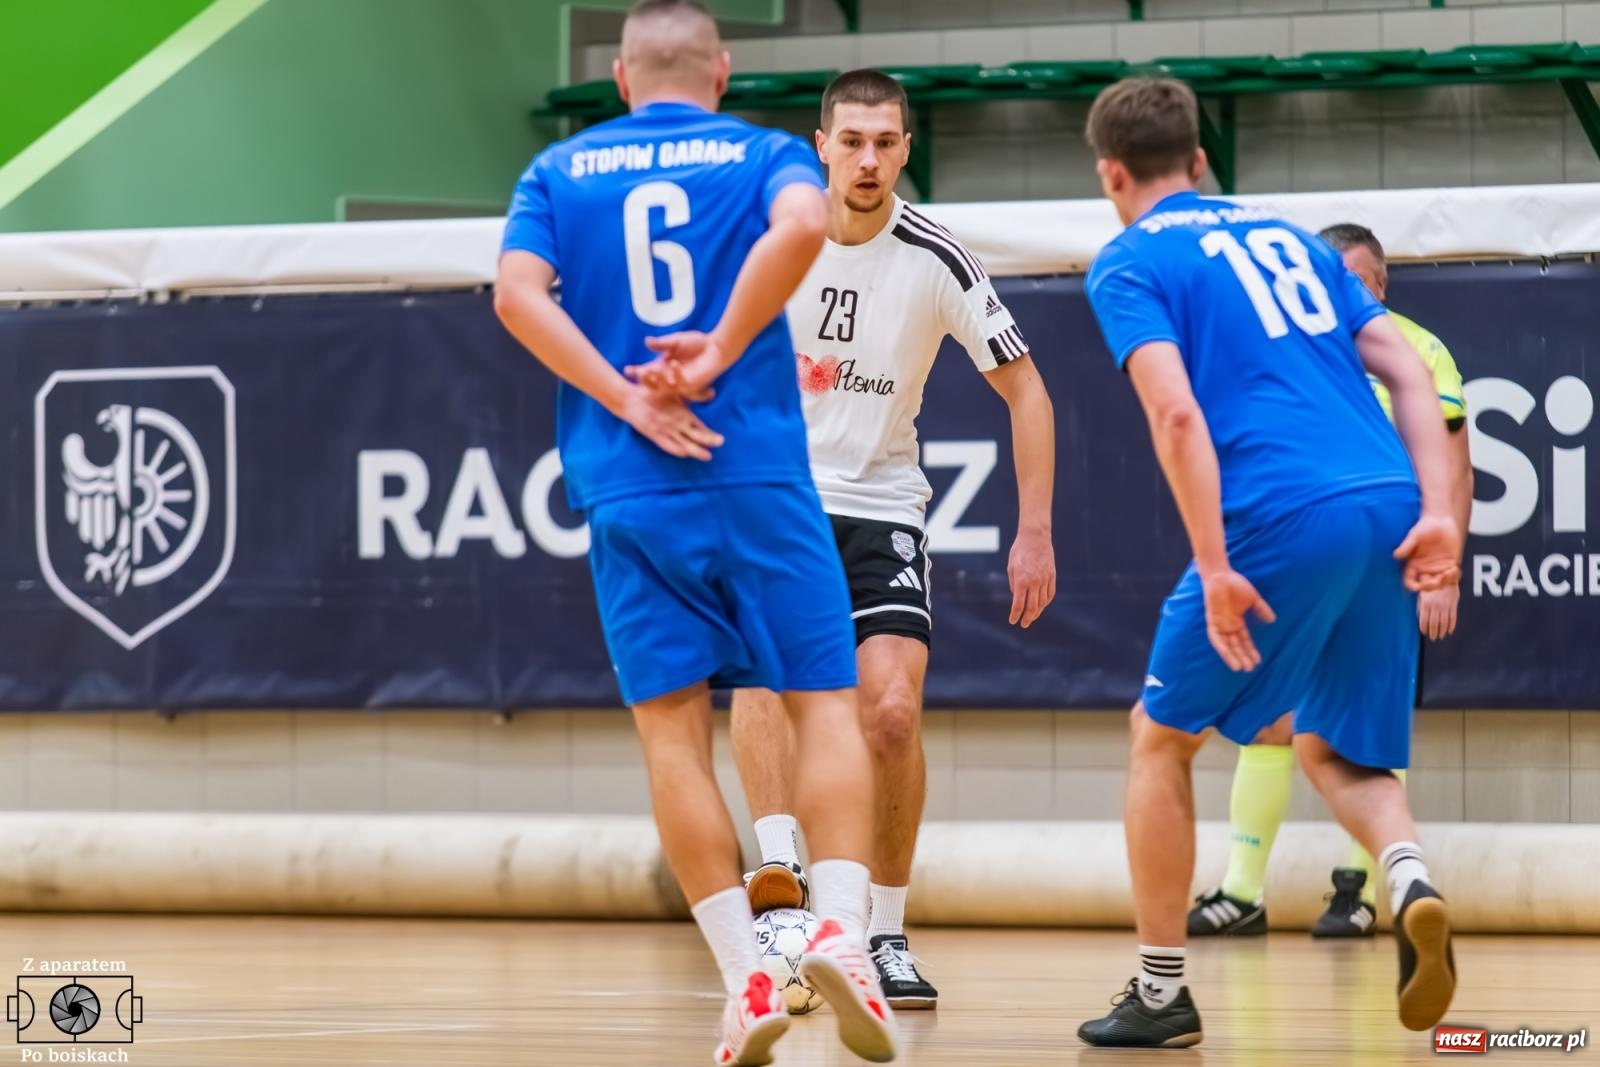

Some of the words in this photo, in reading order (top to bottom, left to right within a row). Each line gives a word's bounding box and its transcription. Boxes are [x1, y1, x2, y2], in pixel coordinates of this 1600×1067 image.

[571, 143, 655, 178] STOPIW
[623, 180, 696, 327] 6
[1199, 227, 1339, 340] 18
[818, 286, 858, 343] 23
